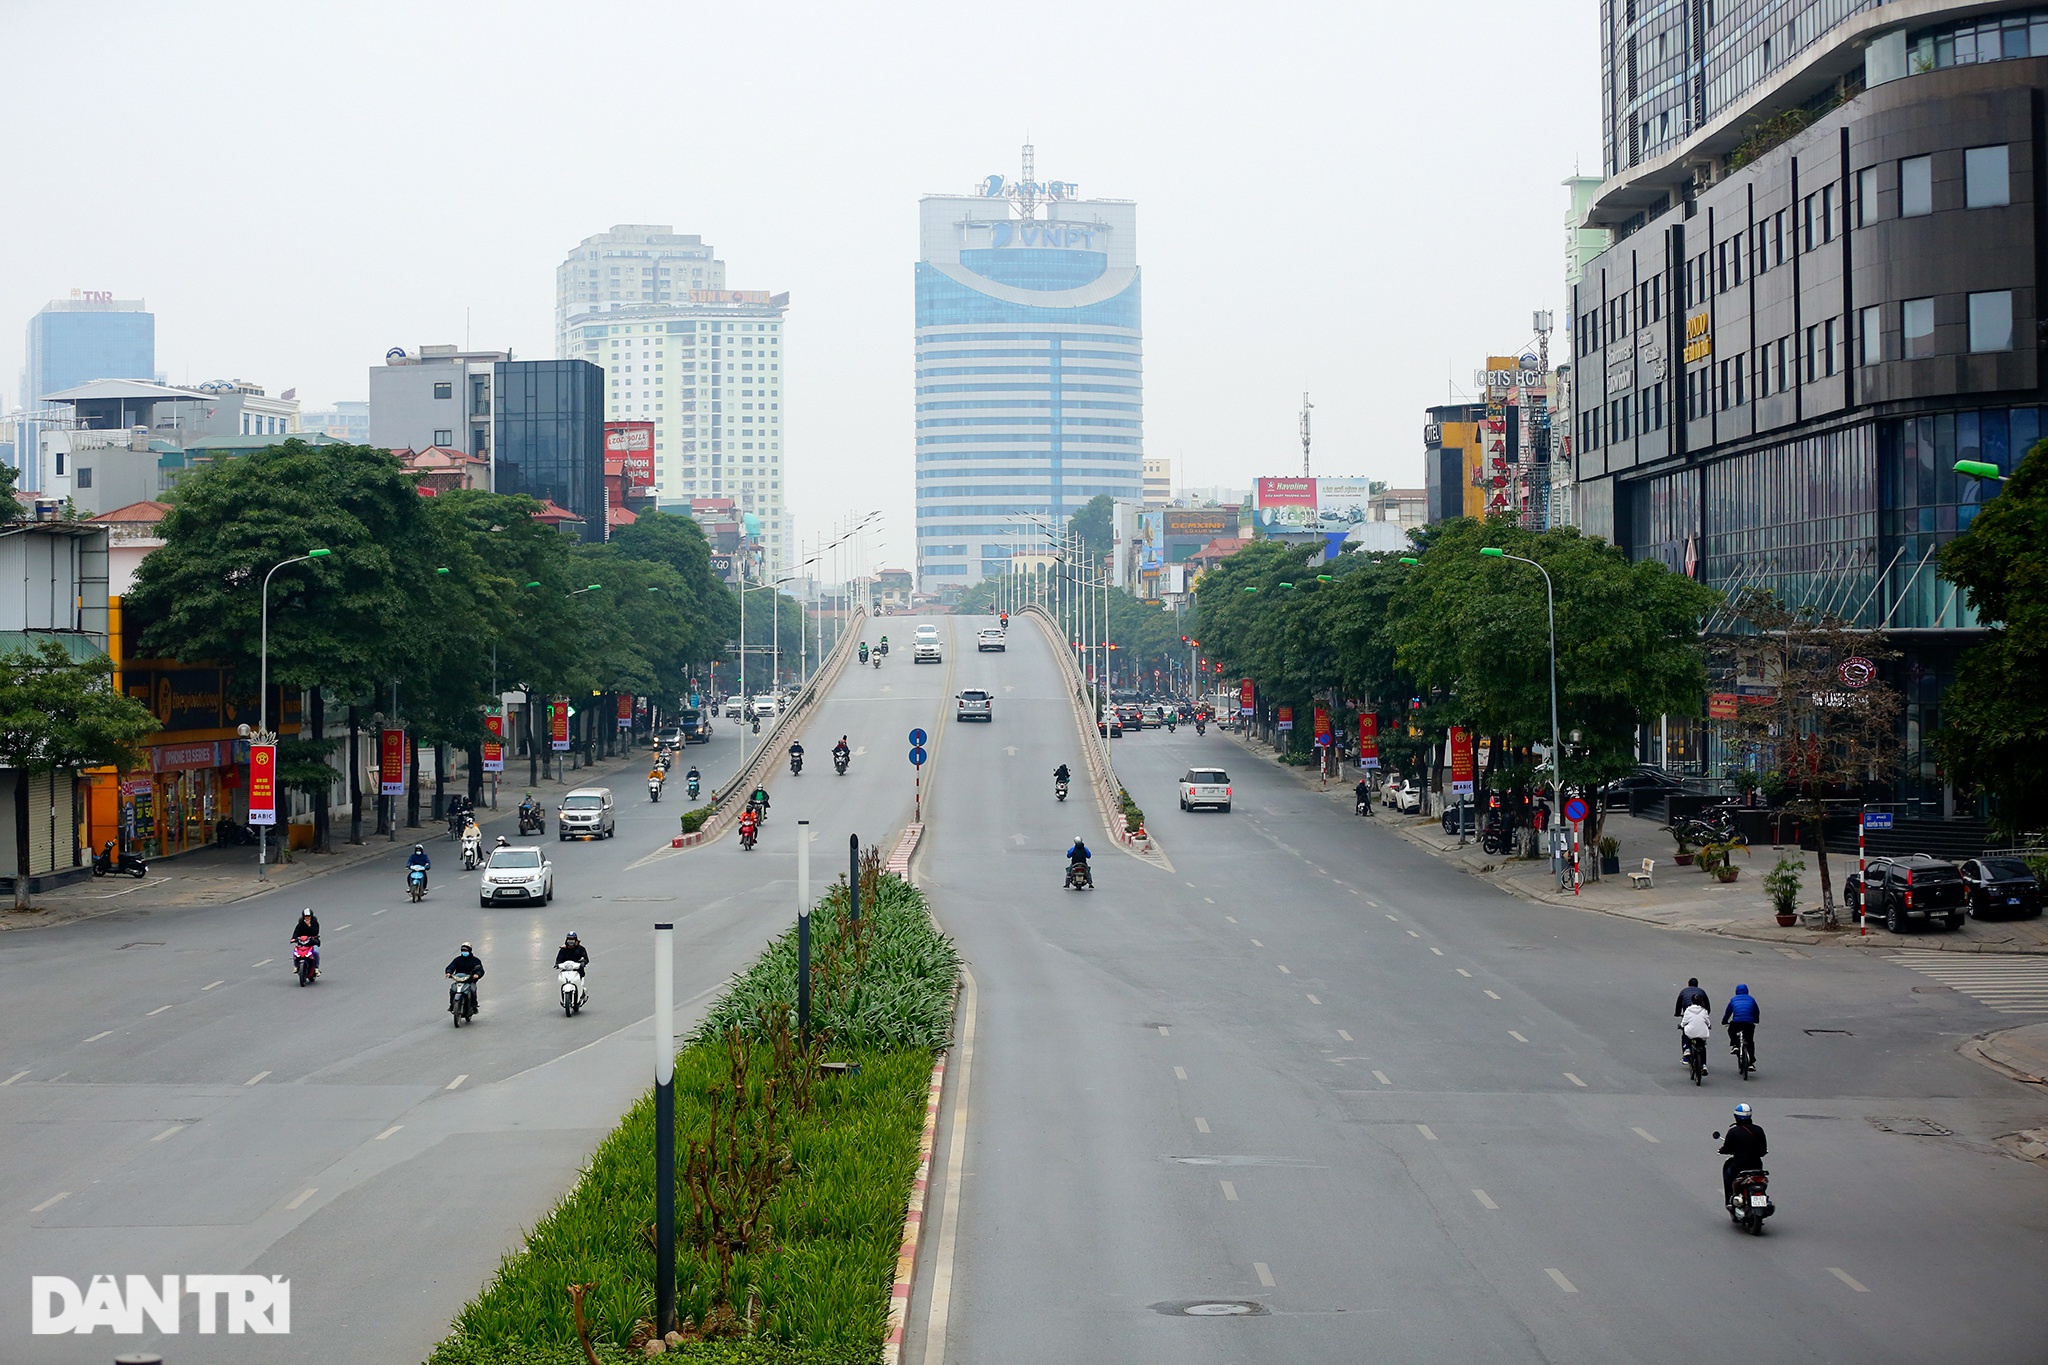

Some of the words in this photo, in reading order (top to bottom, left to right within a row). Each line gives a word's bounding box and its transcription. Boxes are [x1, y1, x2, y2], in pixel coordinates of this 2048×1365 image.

[1021, 228, 1095, 248] VNPT
[82, 290, 114, 305] TNR
[689, 289, 716, 303] SUN
[1476, 370, 1511, 387] OBIS
[1276, 482, 1308, 491] Havoline
[165, 751, 185, 765] IPHONE
[185, 749, 191, 763] 13
[190, 748, 210, 762] SERIES
